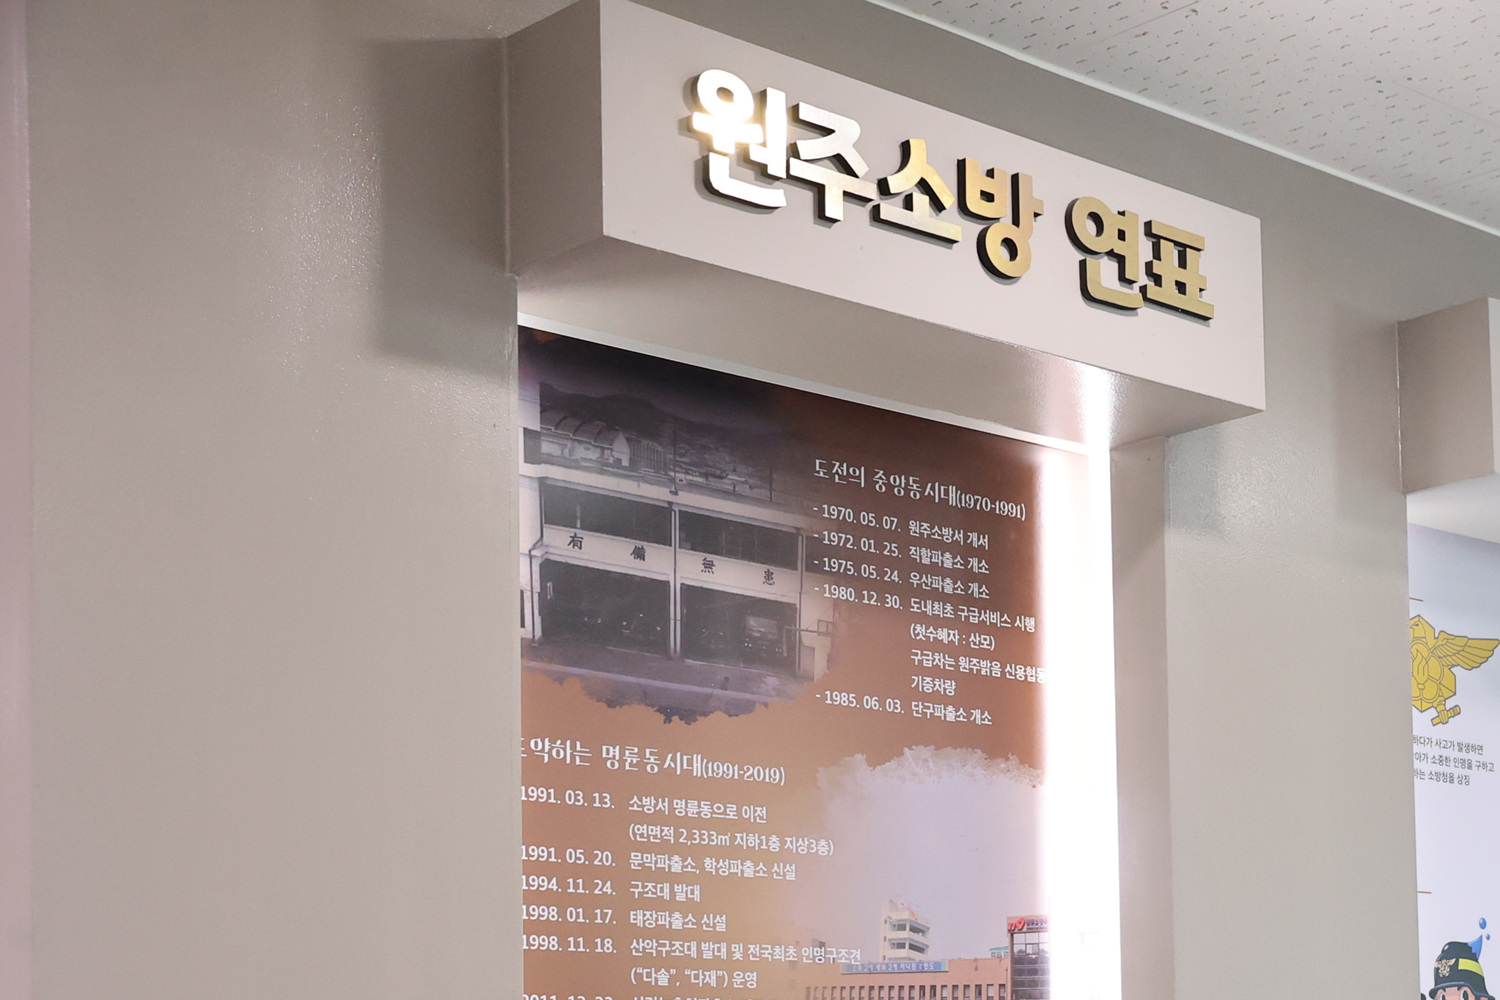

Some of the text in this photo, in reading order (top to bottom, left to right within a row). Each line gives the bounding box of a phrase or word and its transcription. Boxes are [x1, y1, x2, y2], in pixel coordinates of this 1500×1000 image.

[691, 68, 1215, 320] 원주소방 연표
[814, 459, 865, 487] 도전의
[909, 520, 964, 545] 원주소방서
[967, 533, 989, 550] 개서
[909, 546, 965, 569] 직할파출소
[968, 558, 989, 574] 개소
[910, 598, 954, 618] 도내최초
[958, 606, 1011, 628] 구급서비스
[1014, 616, 1035, 632] 시행
[910, 624, 995, 651] (첫수혜자 산모)
[911, 650, 955, 671] 구급차는
[959, 657, 1001, 677] 원주밝음
[911, 675, 956, 696] 기증차량
[912, 701, 967, 722] 단구파출소
[971, 709, 993, 725] 개소
[629, 795, 669, 815] 소방서
[673, 799, 738, 820] 명륜동으로
[742, 805, 767, 823] 이전
[629, 824, 675, 844] (연면적
[734, 832, 780, 852] 지하1층
[784, 837, 833, 856] 지상3층)
[630, 853, 699, 874] 문막파출소,
[703, 857, 768, 877] 학성파출소
[772, 862, 796, 880] 신설
[630, 939, 697, 958] 산악구조대
[702, 942, 727, 959] 발대
[731, 943, 744, 961] 및
[748, 945, 797, 962] 전국최초
[801, 947, 862, 965] 인명구조견
[732, 971, 757, 988] 운영
